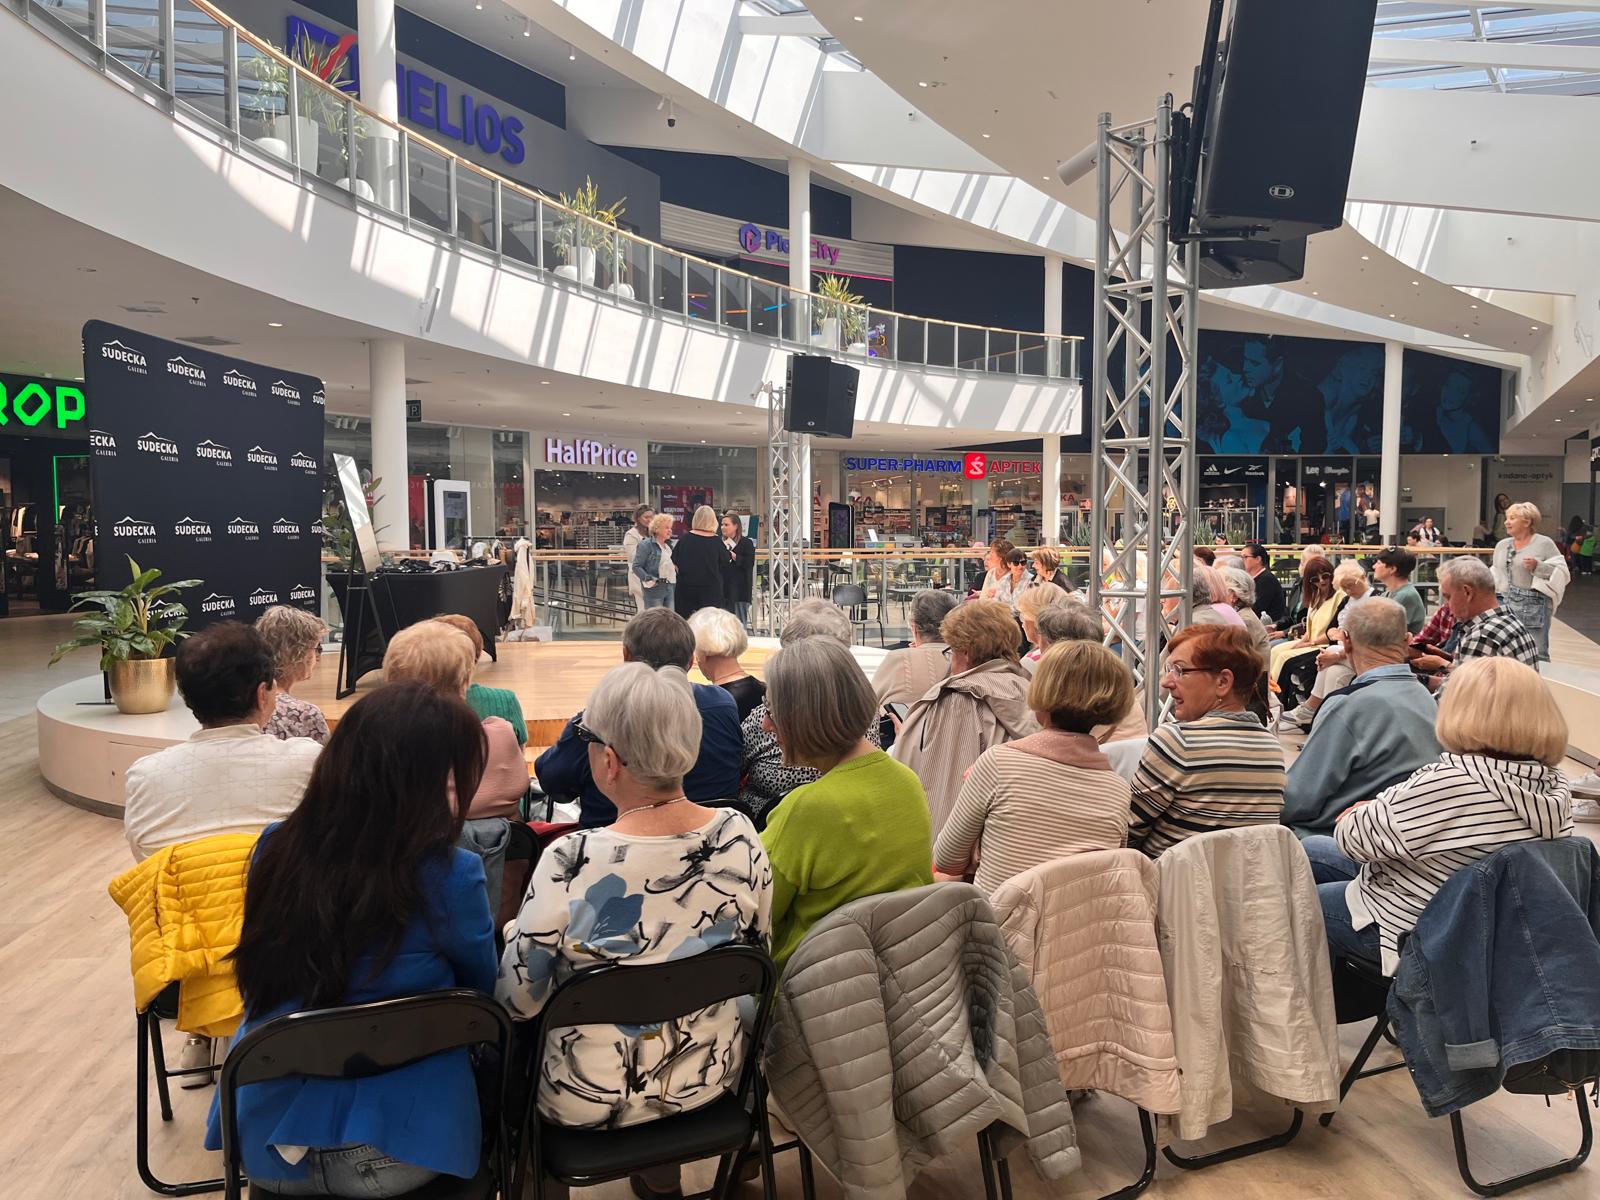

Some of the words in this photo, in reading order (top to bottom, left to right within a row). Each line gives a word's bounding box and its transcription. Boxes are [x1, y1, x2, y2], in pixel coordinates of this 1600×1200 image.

[397, 63, 525, 164] ELIOS
[101, 346, 147, 367] SUDECKA
[127, 366, 148, 375] GALERIA
[167, 362, 206, 380] SUDECKA
[223, 375, 257, 390] SUDECKA
[271, 386, 301, 400] SUDECKA
[137, 440, 179, 455] SUDECKA
[196, 447, 232, 460] SUDECKA
[544, 438, 637, 467] HalfPrice
[247, 453, 278, 465] SUDECKA
[290, 458, 317, 469] SUDECKA
[847, 457, 962, 473] SUPER-PHARM
[113, 526, 156, 537] SUDECKA
[175, 525, 212, 535] SUDECKA
[227, 525, 259, 534] SUDECKA
[272, 525, 300, 534] SUDECKA
[249, 594, 278, 606] SUDECKA
[290, 590, 315, 600] SUDECKA
[201, 599, 235, 612] SUDECKA
